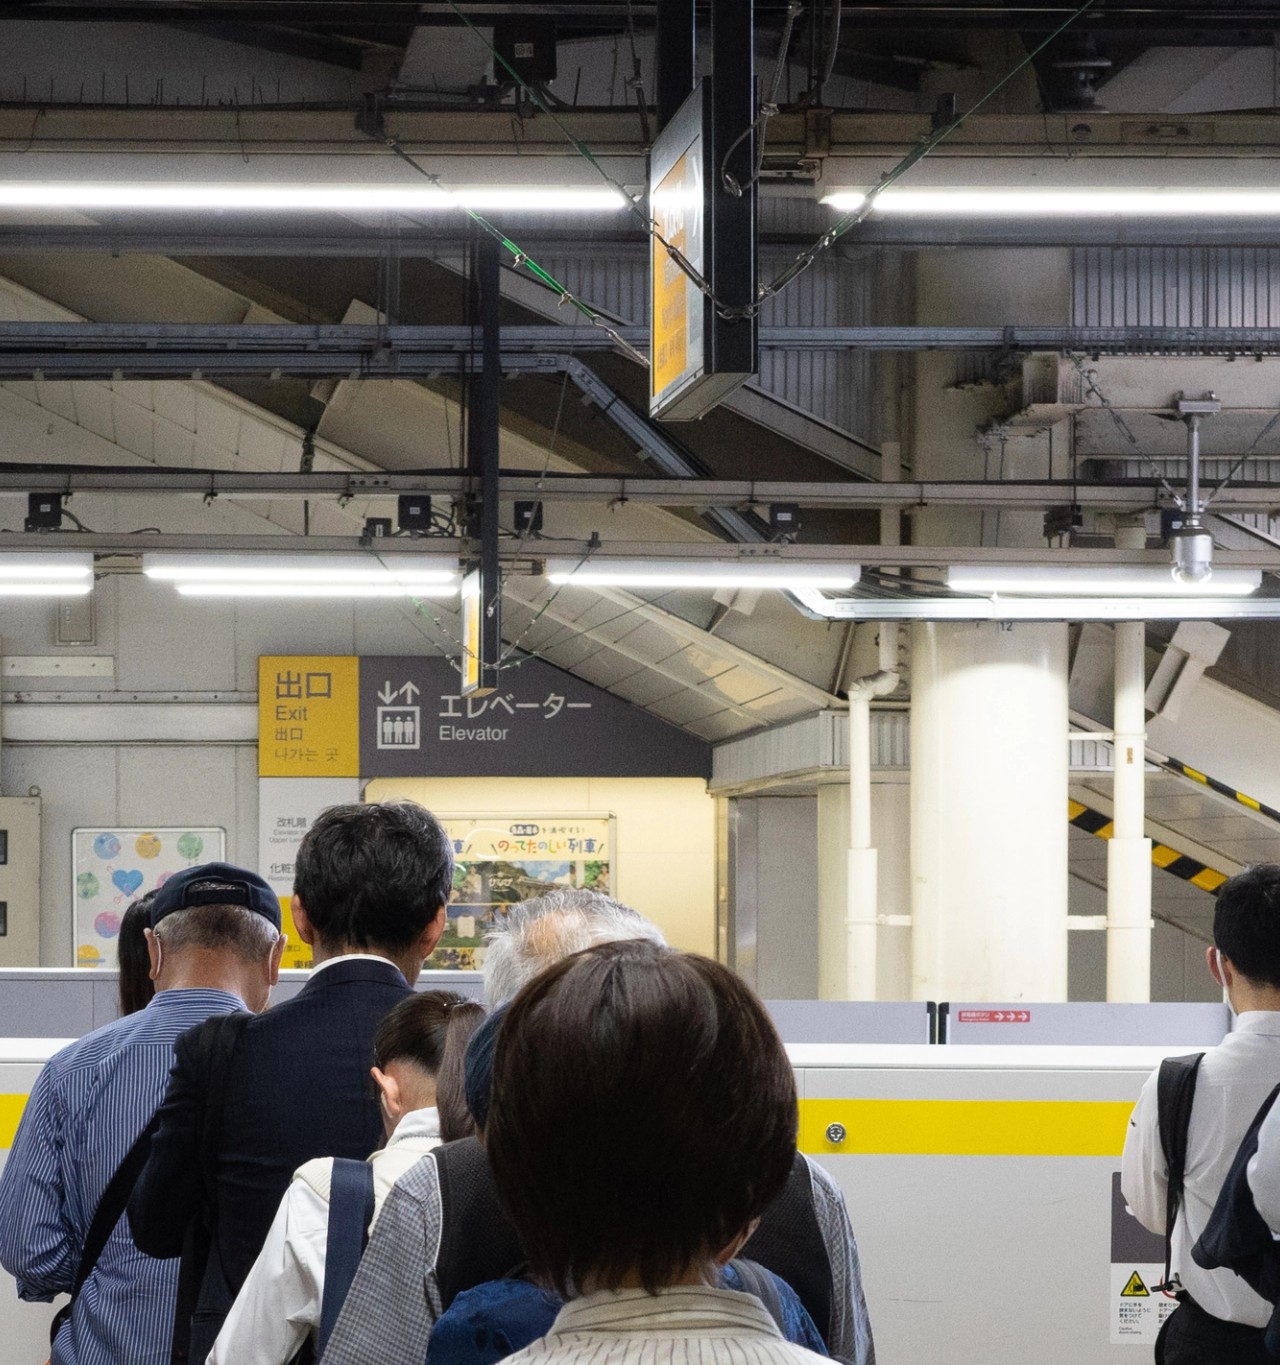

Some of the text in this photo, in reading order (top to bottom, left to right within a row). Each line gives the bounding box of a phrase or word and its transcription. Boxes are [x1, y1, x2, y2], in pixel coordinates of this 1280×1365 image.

[275, 671, 332, 700] 出口
[275, 705, 308, 721] Exit
[439, 693, 592, 719] エレベーター
[275, 727, 303, 741] 出口
[439, 726, 509, 741] Elevator
[275, 749, 319, 762] 나가는
[498, 838, 597, 854] のってたのしい列車
[270, 863, 296, 874] 化粧
